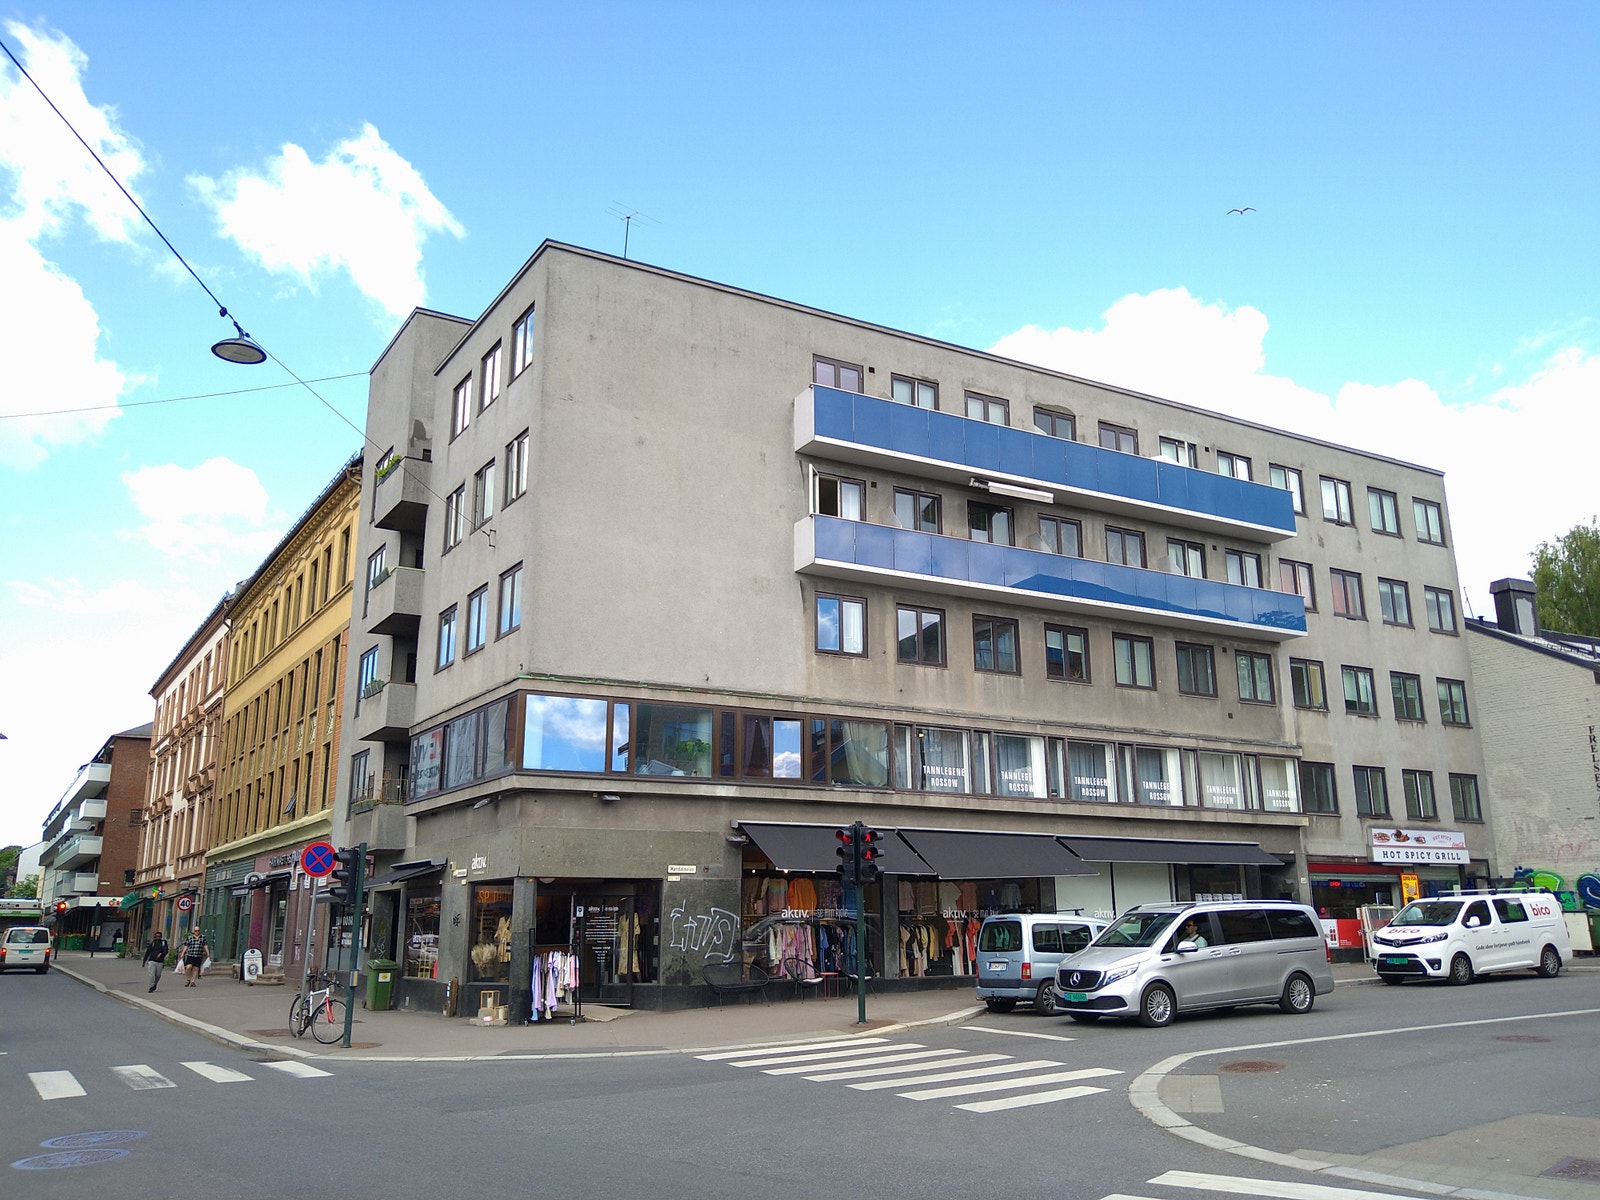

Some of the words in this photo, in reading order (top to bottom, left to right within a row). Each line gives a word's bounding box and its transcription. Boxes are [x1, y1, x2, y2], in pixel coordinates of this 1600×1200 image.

[922, 765, 965, 777] TANNLEGENE
[1001, 771, 1033, 781] TANNLEGE
[930, 778, 958, 788] ROSSOW
[1008, 783, 1035, 793] ROSSOW
[1081, 788, 1105, 797] ROSSOW
[1149, 792, 1172, 801] ROSSOW
[1212, 796, 1234, 805] ROSSOW
[1382, 850, 1401, 859] HOT
[1405, 851, 1431, 860] SPICY
[1435, 852, 1461, 861] GRILL
[180, 899, 191, 908] 40
[781, 906, 809, 918] aktiv.
[943, 906, 967, 918] aktiv.
[1530, 903, 1551, 916] bico
